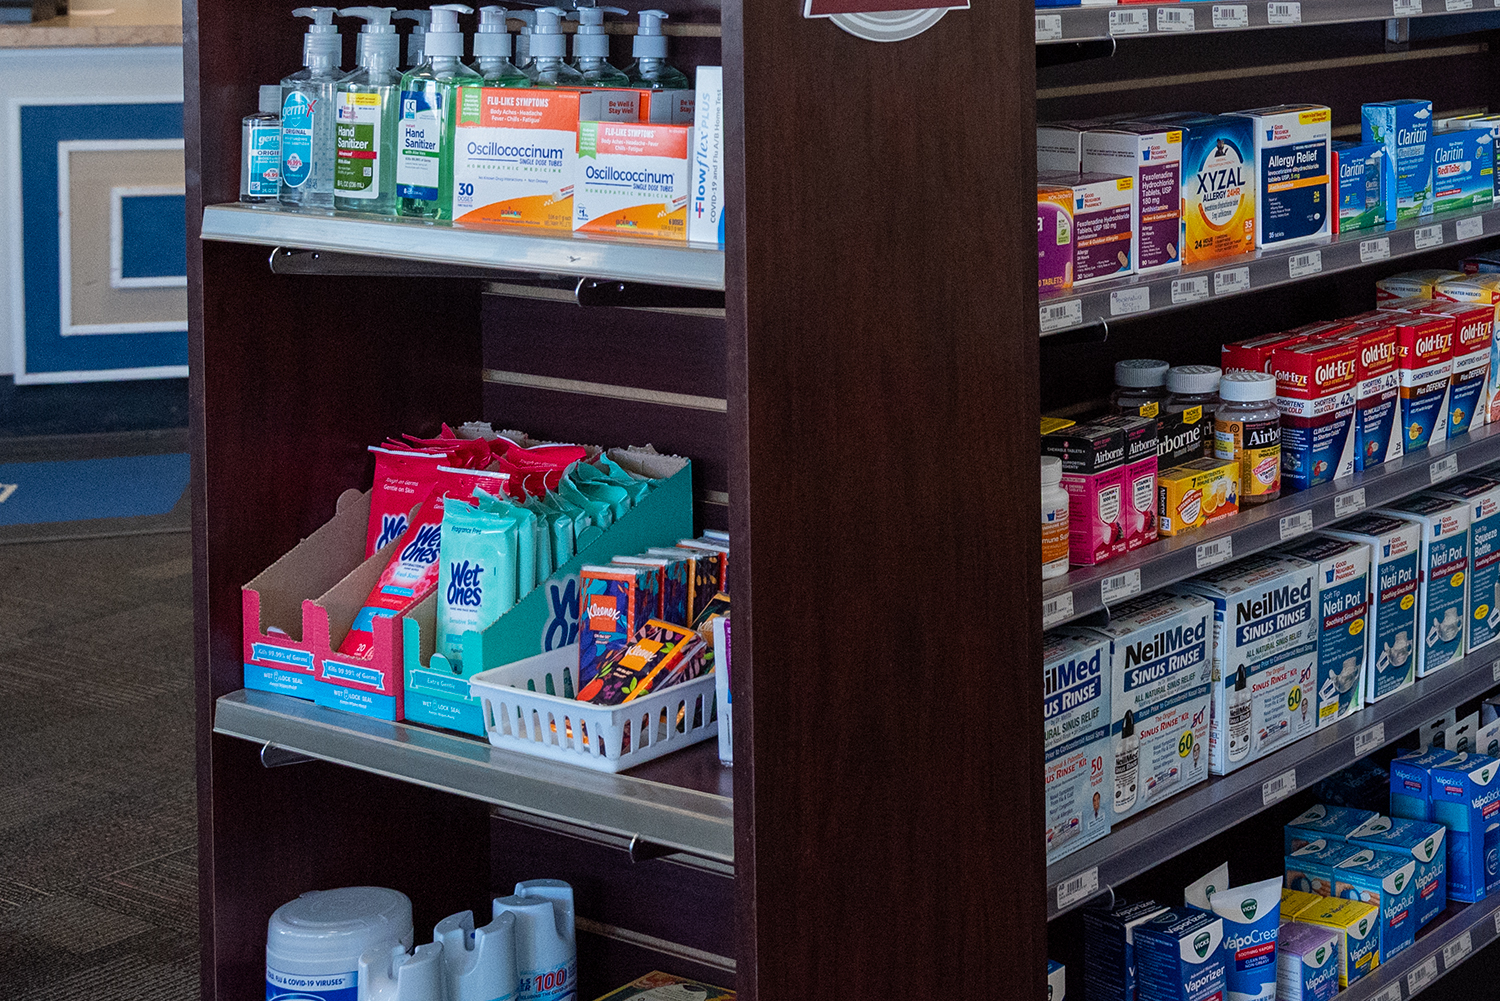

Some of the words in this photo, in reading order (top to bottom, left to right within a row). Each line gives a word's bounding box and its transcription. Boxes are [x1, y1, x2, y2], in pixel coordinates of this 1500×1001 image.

[487, 97, 514, 106] FLU-LIKE
[516, 99, 548, 107] SYMPTOMS
[701, 93, 710, 129] PLUS
[338, 126, 354, 137] Hand
[406, 129, 424, 138] Hand
[1398, 127, 1427, 146] Claritin
[338, 137, 368, 149] Sanitizer
[405, 139, 436, 150] Sanitizer
[467, 142, 562, 159] Oscillococcinum
[1268, 154, 1295, 169] Allergy
[1296, 150, 1318, 163] Relief
[1435, 146, 1463, 163] Claritin
[586, 166, 673, 184] Oscillococcinum
[695, 132, 710, 218] Flowflex
[1196, 167, 1246, 194] XYZAL
[458, 183, 474, 196] 30
[1315, 358, 1356, 385] Cold-EEZE
[1094, 448, 1124, 464] Airborne
[1474, 528, 1498, 546] Squeeze
[450, 560, 483, 585] Wet
[1380, 571, 1397, 590] Neti
[1398, 566, 1412, 583] Pot
[447, 584, 482, 607] Ones
[1236, 577, 1311, 625] NeilMed
[1323, 600, 1343, 617] Neti
[1345, 591, 1361, 607] Pot
[587, 605, 620, 621] Kleenex
[1242, 619, 1274, 643] SINUS
[1277, 607, 1306, 630] RINSE
[1124, 620, 1206, 669] NeilMed
[1131, 661, 1165, 687] SINUS
[1168, 650, 1200, 671] RINSE
[1179, 734, 1192, 753] 60
[535, 969, 565, 993] 100
[1185, 965, 1225, 993] Vaporizer
[1306, 966, 1336, 991] VapoRub
